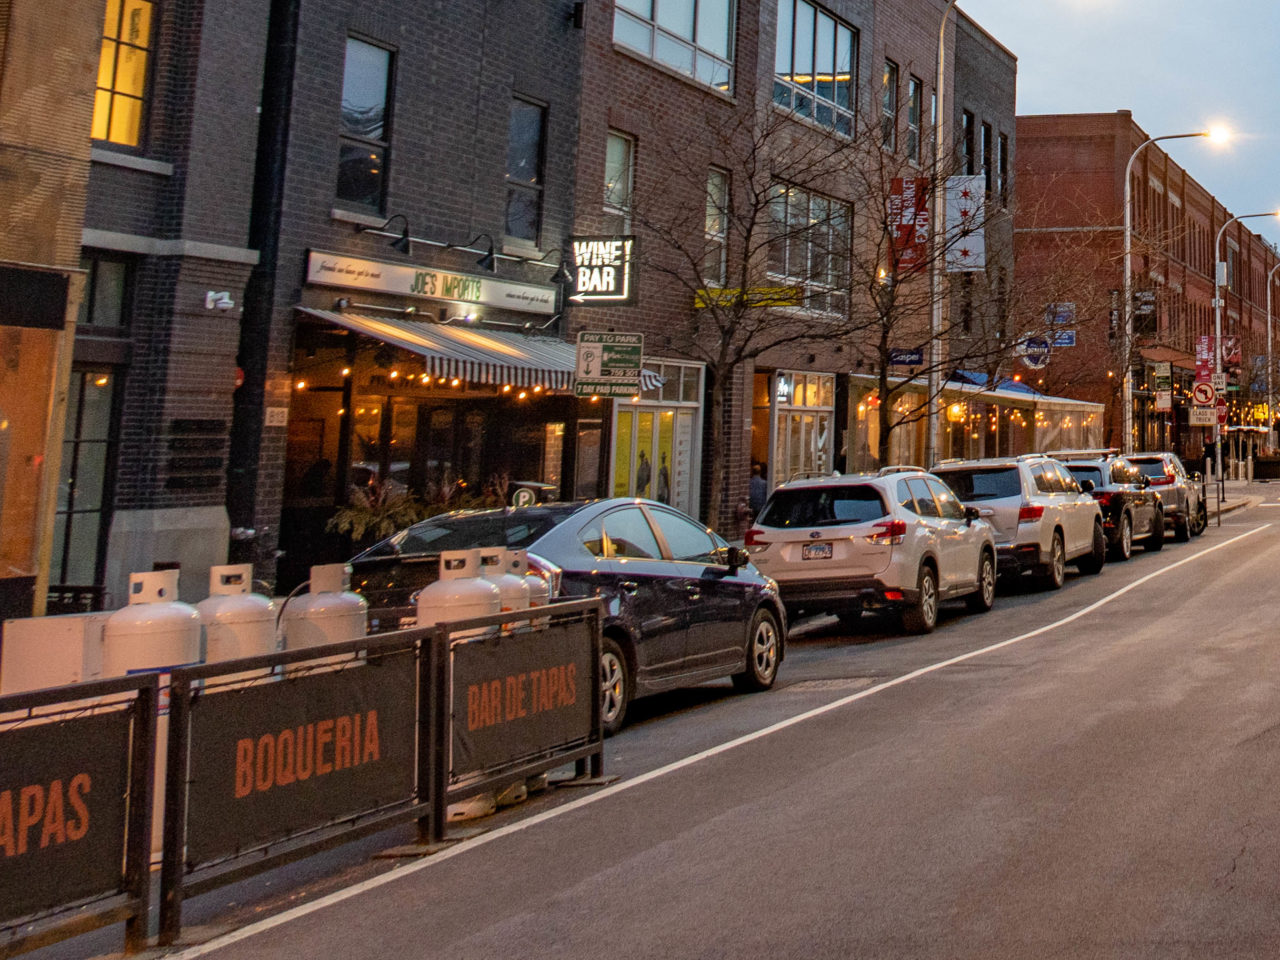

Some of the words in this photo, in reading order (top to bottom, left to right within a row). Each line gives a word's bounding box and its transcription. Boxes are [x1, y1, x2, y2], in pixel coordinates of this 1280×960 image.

[915, 211, 928, 244] EXPO
[573, 240, 622, 266] WINE
[411, 270, 438, 295] JOE'S
[441, 275, 482, 301] IMPORTS
[577, 266, 615, 291] BAR
[615, 335, 639, 343] PARK
[891, 351, 920, 363] Casper
[611, 385, 639, 394] PARKING
[518, 491, 530, 506] P
[467, 680, 502, 731] BAR
[505, 673, 527, 721] DE
[530, 662, 577, 715] TAPAS
[235, 710, 380, 798] BOQUERIA
